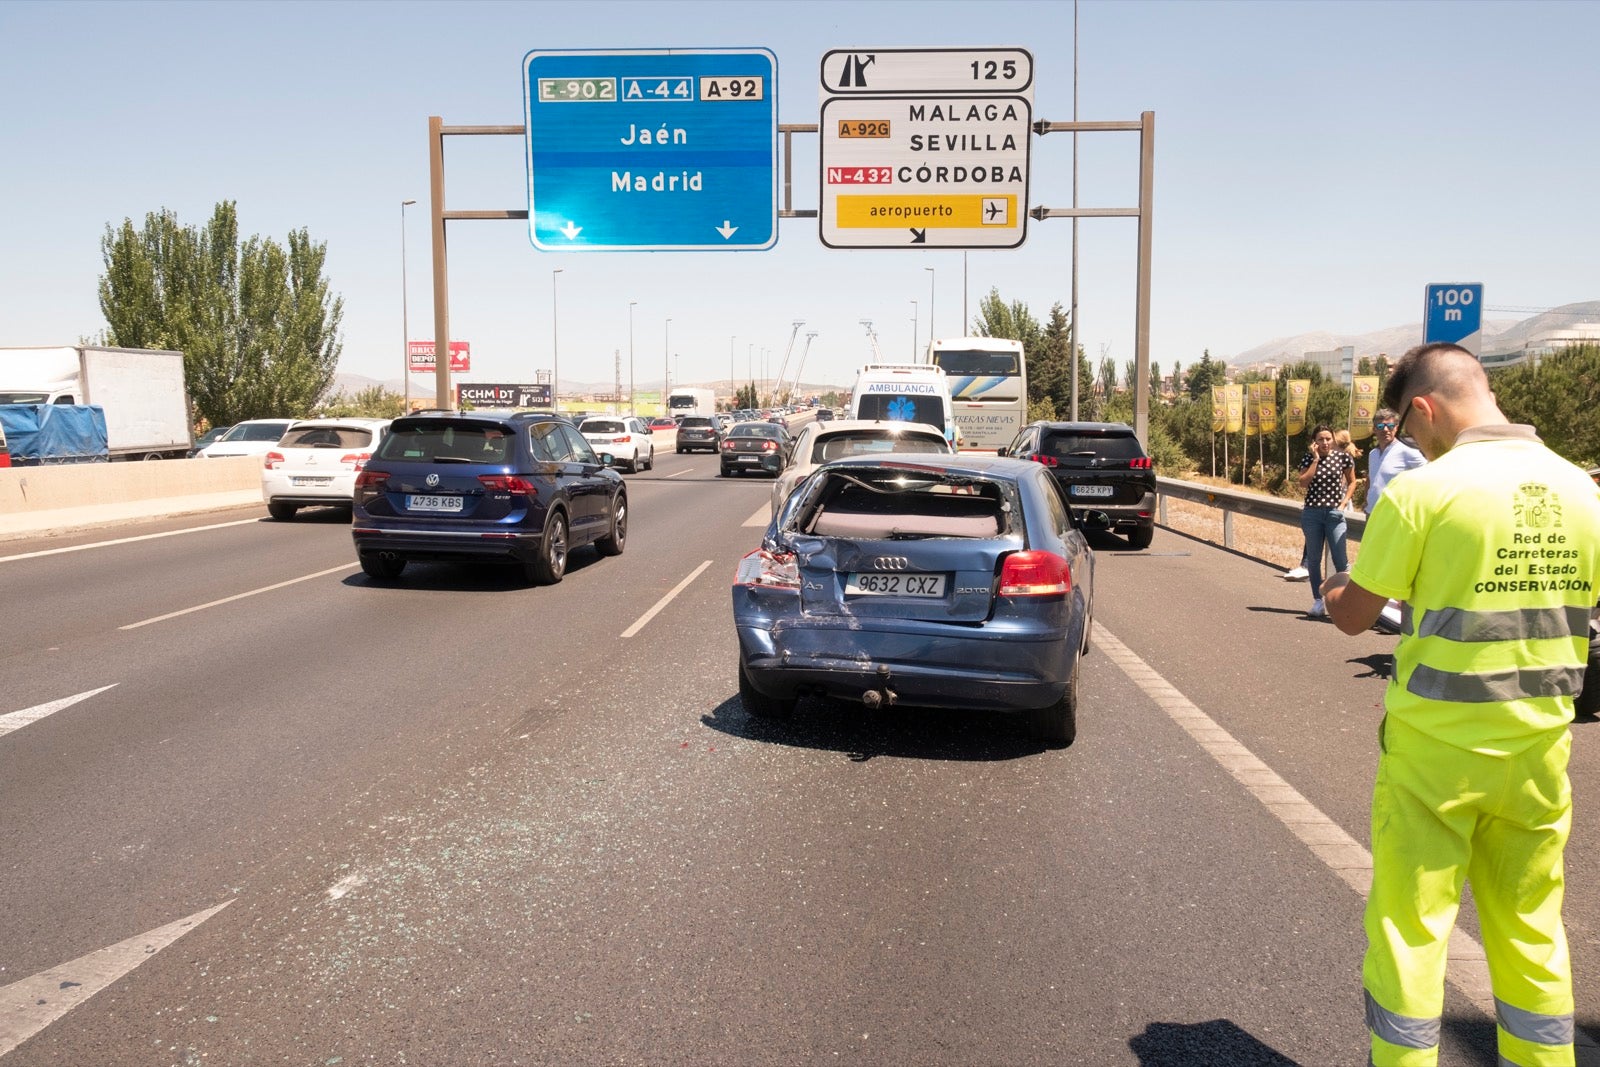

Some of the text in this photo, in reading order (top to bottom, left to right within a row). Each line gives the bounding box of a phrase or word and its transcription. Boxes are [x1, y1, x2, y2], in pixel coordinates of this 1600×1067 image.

[970, 60, 1016, 80] 125
[542, 81, 613, 99] E-902
[626, 81, 689, 98] A-44
[707, 79, 757, 97] A-92
[909, 104, 1018, 121] MALAGA
[620, 122, 687, 145] Jaén
[840, 123, 889, 136] A-92G
[910, 134, 1017, 151] SEVILLA
[829, 170, 891, 183] N-432
[898, 162, 1023, 183] CÓRDOBA
[611, 171, 703, 192] Madrid
[870, 205, 953, 218] aeropuerto
[1436, 289, 1474, 306] 100
[1444, 308, 1462, 321] m
[868, 383, 936, 394] AMBULANCIA
[1075, 486, 1112, 494] 6625 KPY
[412, 496, 462, 508] 4736 KBS
[1513, 533, 1566, 544] Red de
[1496, 548, 1578, 559] Carreteras
[1494, 564, 1577, 575] del Estado
[858, 575, 939, 595] 9632 CXZ
